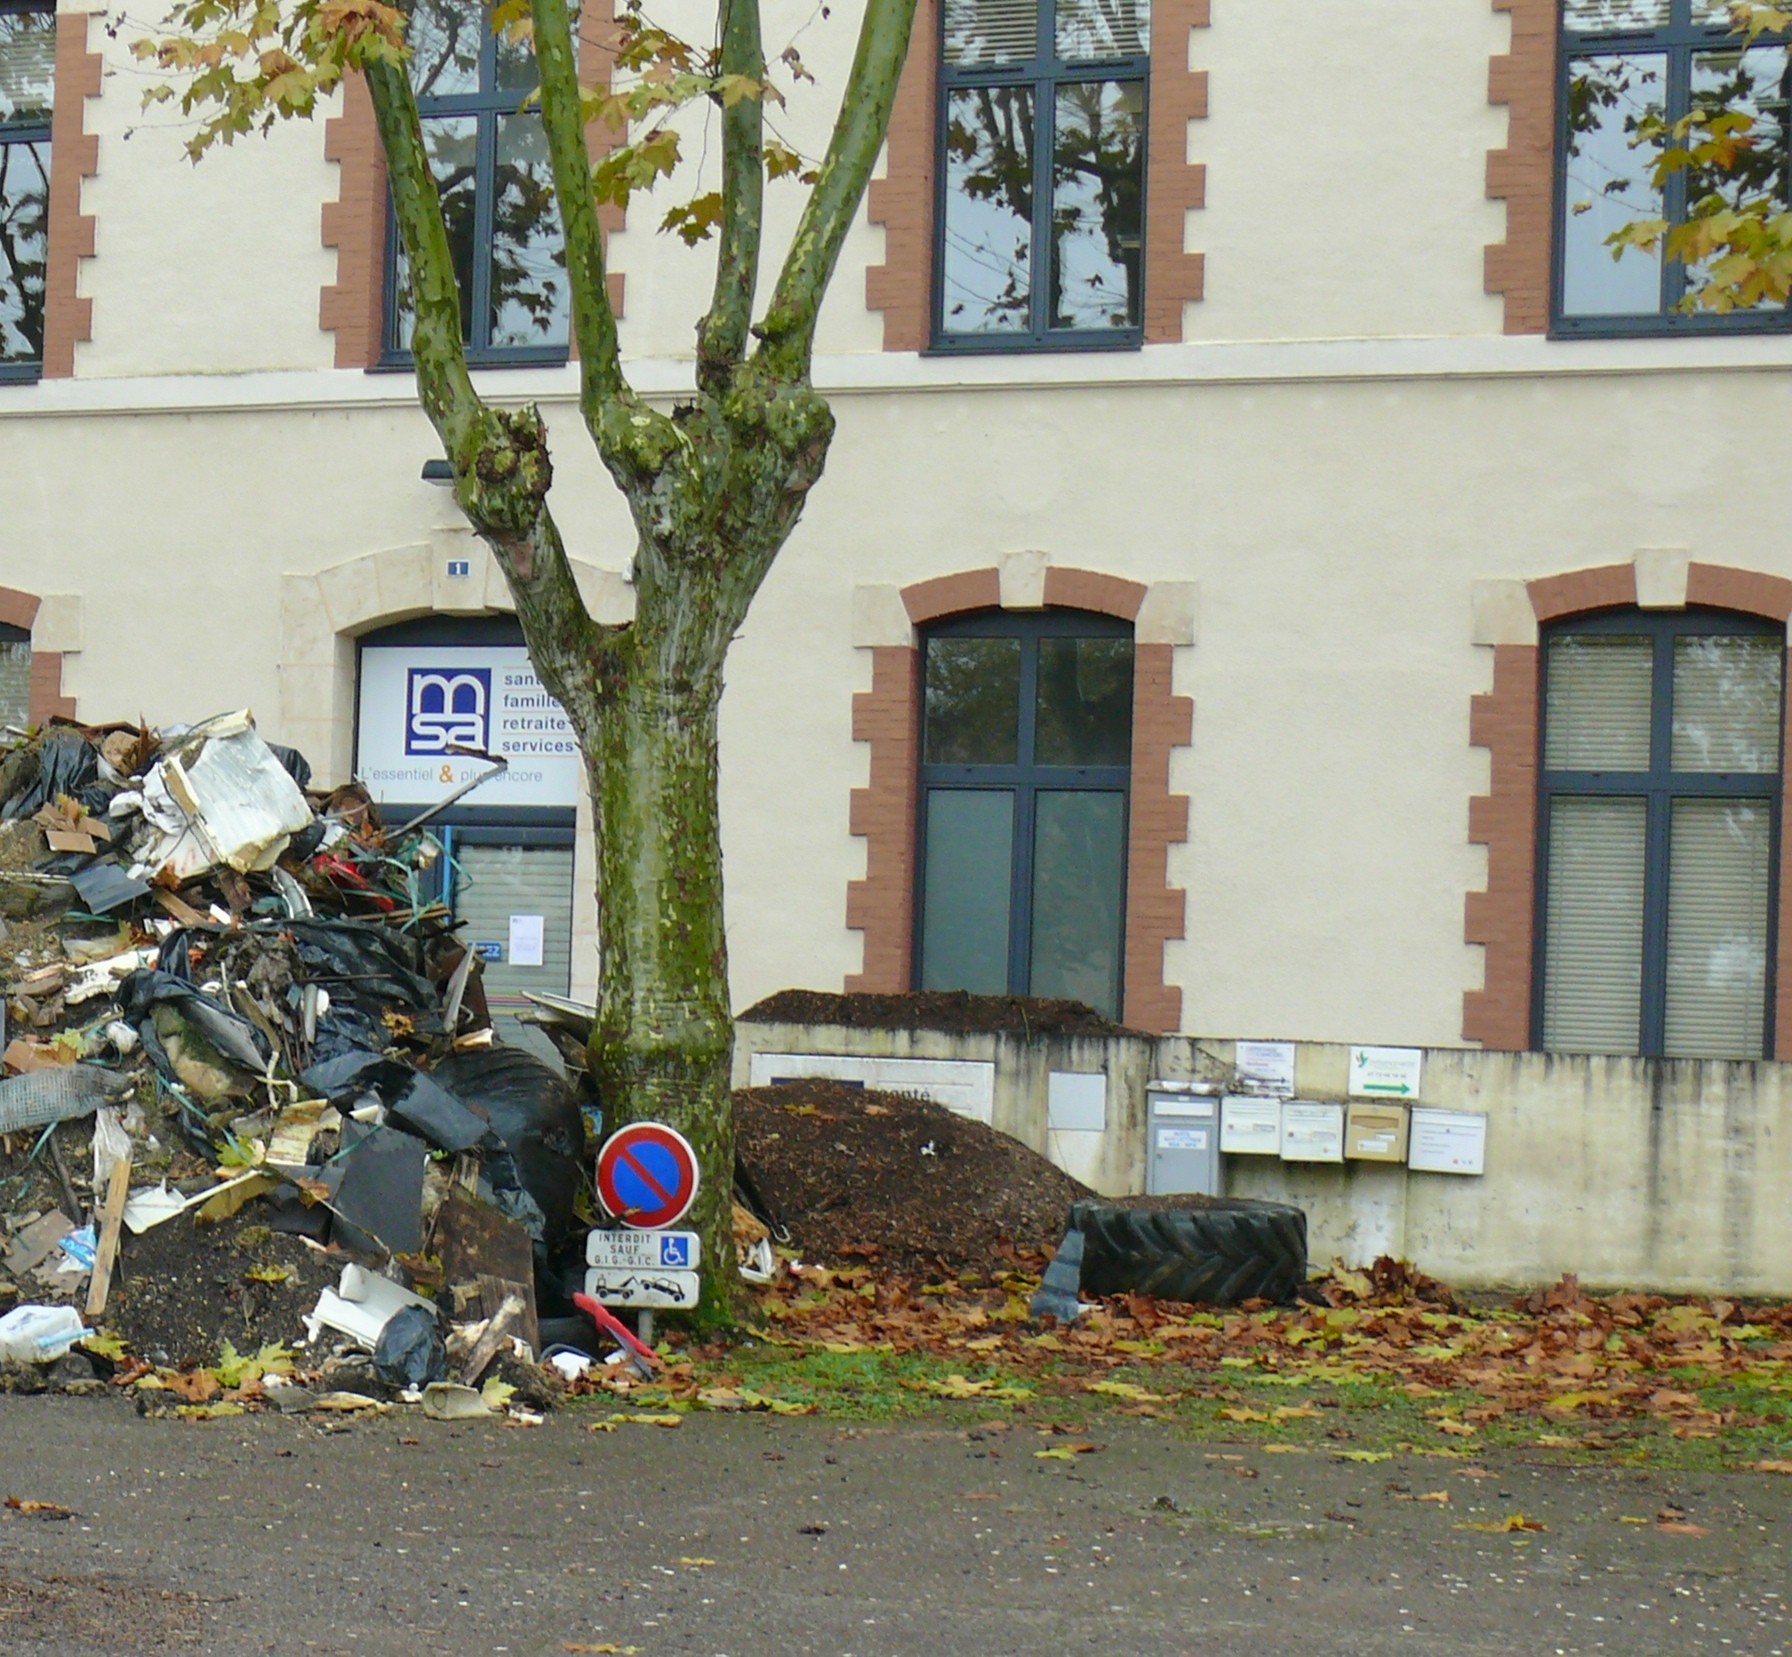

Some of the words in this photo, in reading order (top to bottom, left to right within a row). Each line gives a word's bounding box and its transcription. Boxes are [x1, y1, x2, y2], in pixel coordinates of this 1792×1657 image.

[504, 674, 541, 686] san
[503, 694, 560, 708] famille
[411, 674, 487, 751] msa
[503, 717, 566, 730] retraite
[502, 739, 574, 753] services
[361, 768, 433, 783] L'essentiel
[439, 764, 454, 784] &
[599, 1233, 651, 1244] INTERDIT
[610, 1244, 639, 1255] SAUF
